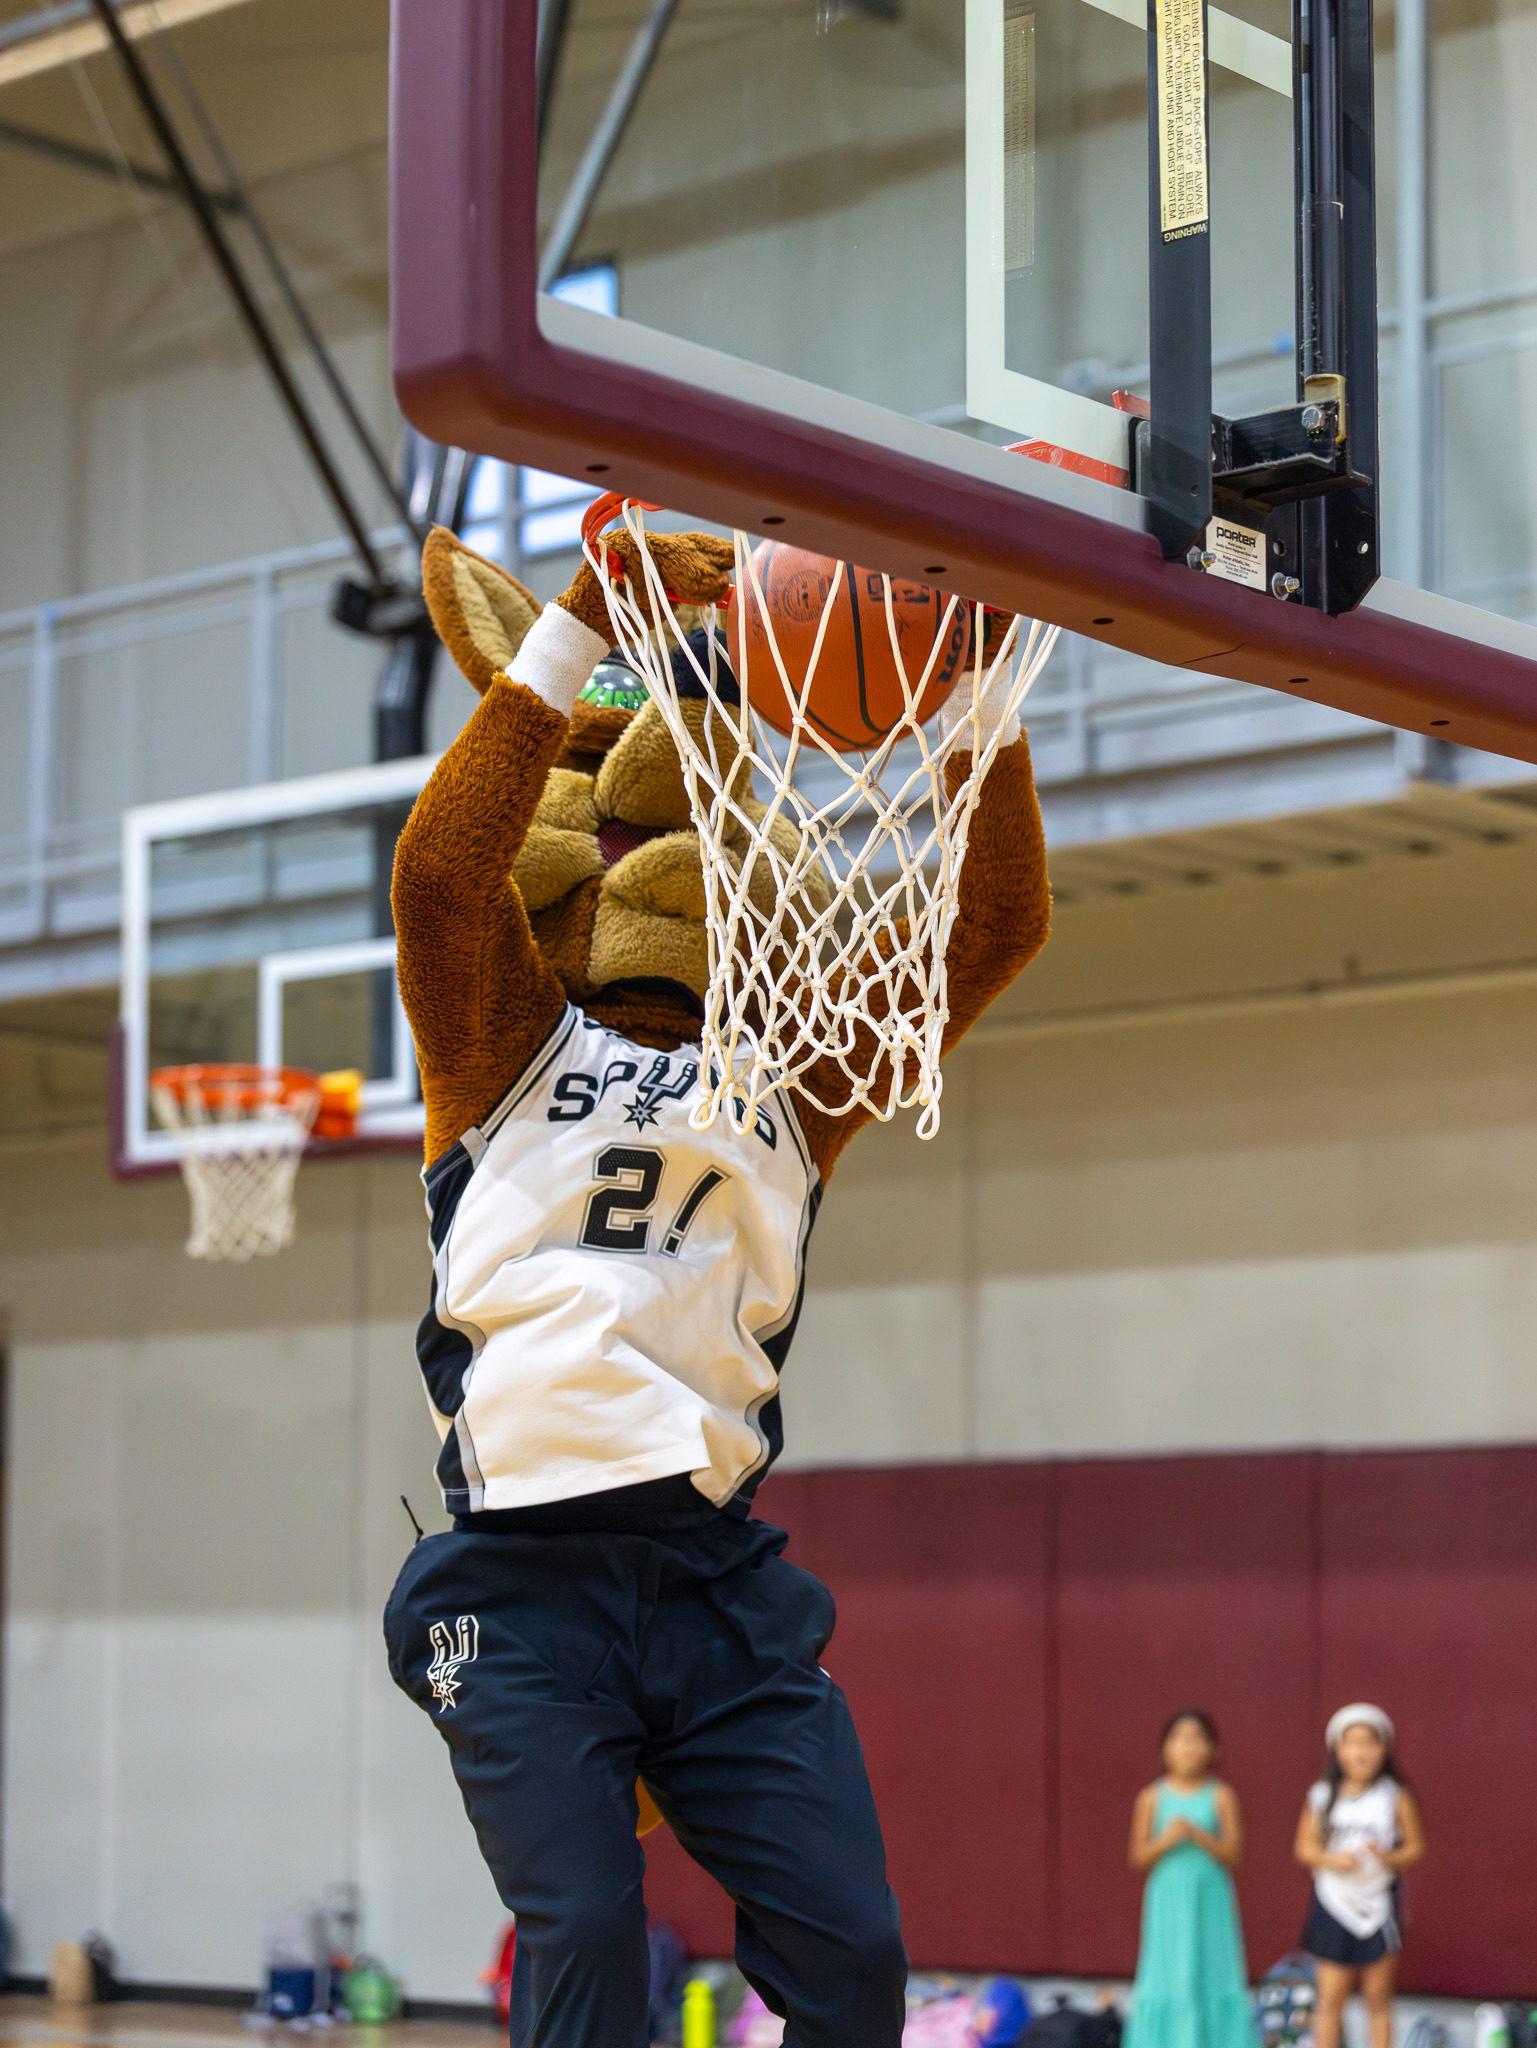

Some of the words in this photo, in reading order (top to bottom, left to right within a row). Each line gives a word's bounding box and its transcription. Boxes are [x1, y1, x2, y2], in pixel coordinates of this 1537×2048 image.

[1191, 0, 1200, 38] EILING
[1164, 21, 1174, 89] ADJUSTMENT
[1173, 28, 1182, 51] UNIT
[1182, 24, 1191, 56] GOAL
[1174, 55, 1182, 69] TO
[1192, 43, 1201, 92] FOLD-UP
[1175, 72, 1183, 124] ELIMINATE
[1183, 62, 1192, 103] HEIGHT
[1166, 92, 1174, 115] UNIT
[1185, 111, 1193, 125] TO
[1167, 119, 1175, 140] AND
[1176, 125, 1184, 162] UNDUE
[1193, 97, 1202, 165] BACKSTOPS
[1168, 177, 1176, 222] SYSTEM.
[1177, 164, 1185, 201] STRAIN
[1185, 172, 1195, 218] BEFORE
[1195, 171, 1204, 215] ALWAYS
[1178, 204, 1186, 220] ON
[1163, 223, 1208, 242] WARNING
